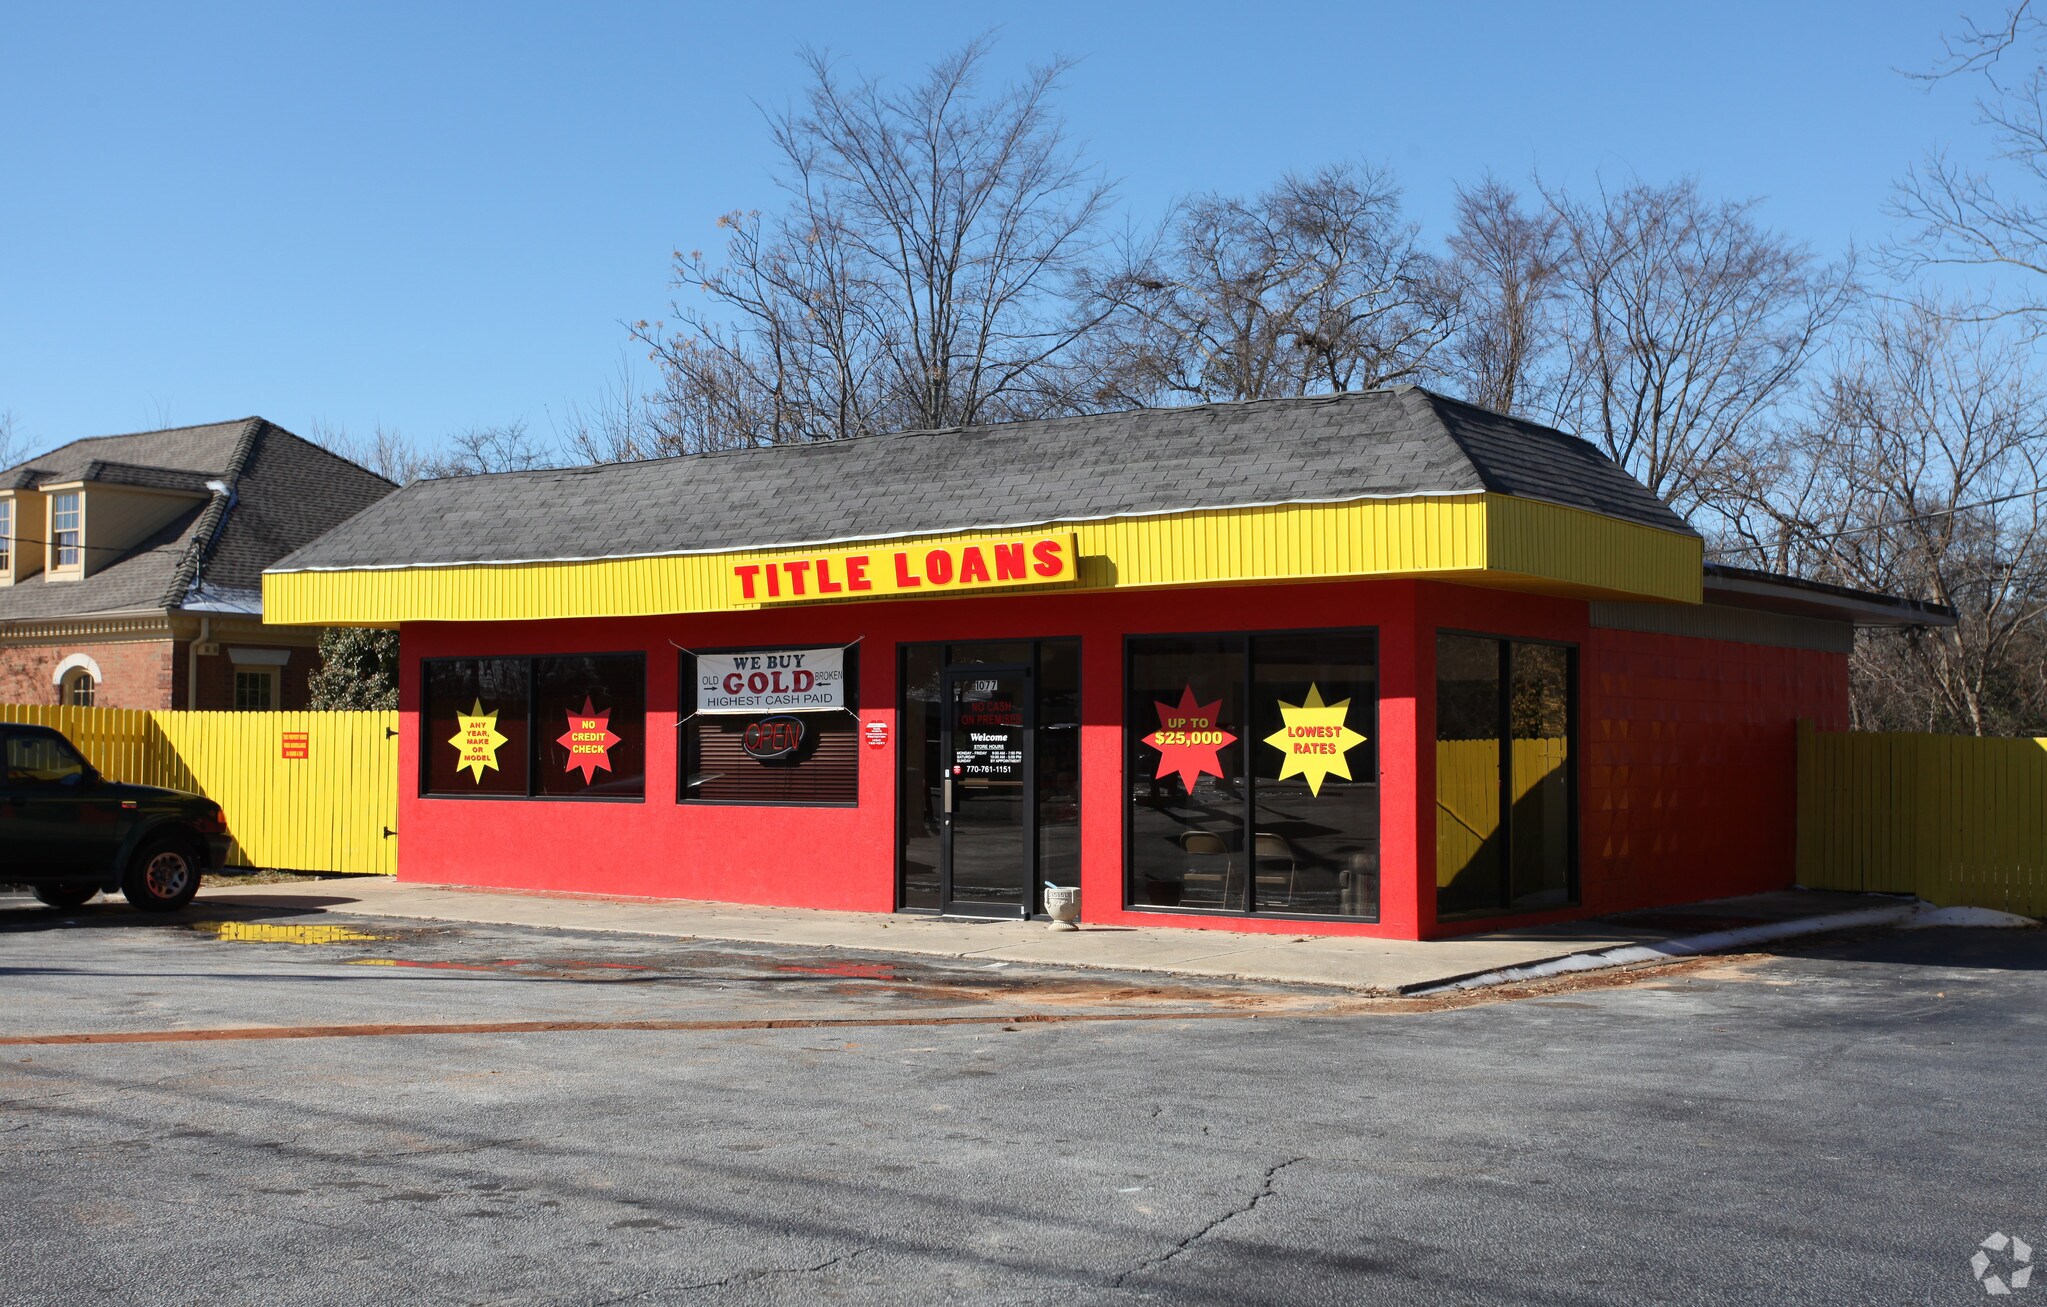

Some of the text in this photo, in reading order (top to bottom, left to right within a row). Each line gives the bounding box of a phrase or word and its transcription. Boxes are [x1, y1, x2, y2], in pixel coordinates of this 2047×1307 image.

[734, 539, 1064, 599] TITLE LOANS
[733, 654, 805, 670] WE BUY
[702, 675, 719, 685] OLD
[814, 670, 843, 681] BROKEN
[723, 670, 815, 695] GOLD
[975, 680, 997, 690] 1077
[707, 693, 833, 706] HIGHEST CASH PAID
[972, 701, 1011, 712] NO CASH
[582, 720, 596, 729] NO
[962, 714, 974, 725] ON
[1168, 718, 1209, 728] UP TO
[571, 732, 606, 742] CREDIT
[745, 723, 801, 750] OPEN
[970, 732, 1008, 742] Welcome
[1287, 725, 1343, 738] LOWEST
[1155, 731, 1223, 747] $25,000
[572, 744, 605, 754] CHECK
[1293, 742, 1337, 755] RATES
[966, 765, 1011, 773] 770-761-1151
